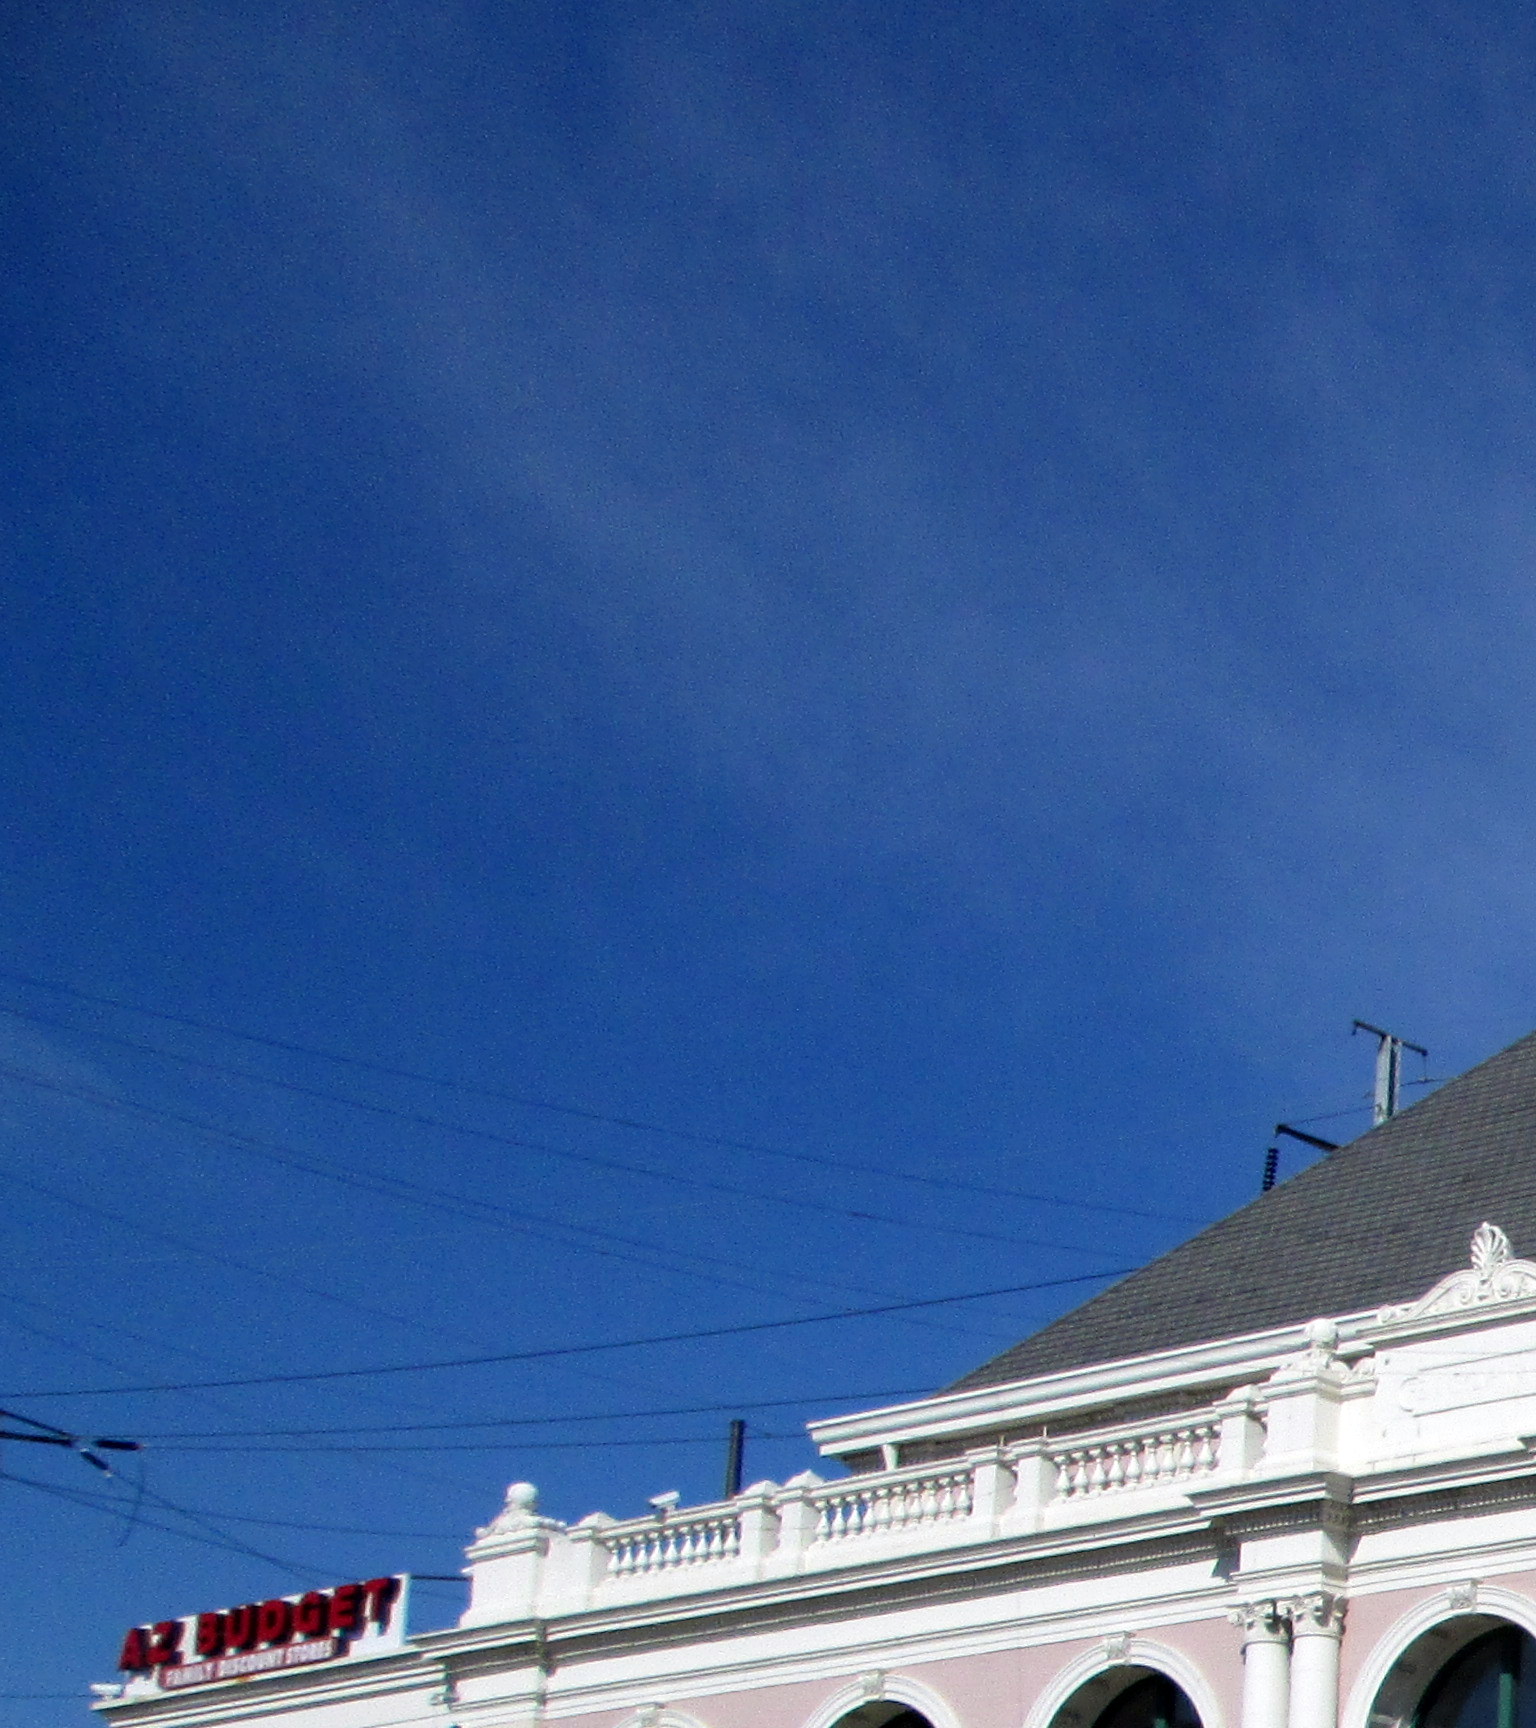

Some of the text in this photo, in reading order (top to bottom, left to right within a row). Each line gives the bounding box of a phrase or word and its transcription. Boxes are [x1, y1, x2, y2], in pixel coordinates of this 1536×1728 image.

[119, 1577, 396, 1669] AZ BUDGET
[217, 1648, 285, 1678] DISCOUNT
[285, 1638, 334, 1666] STORES
